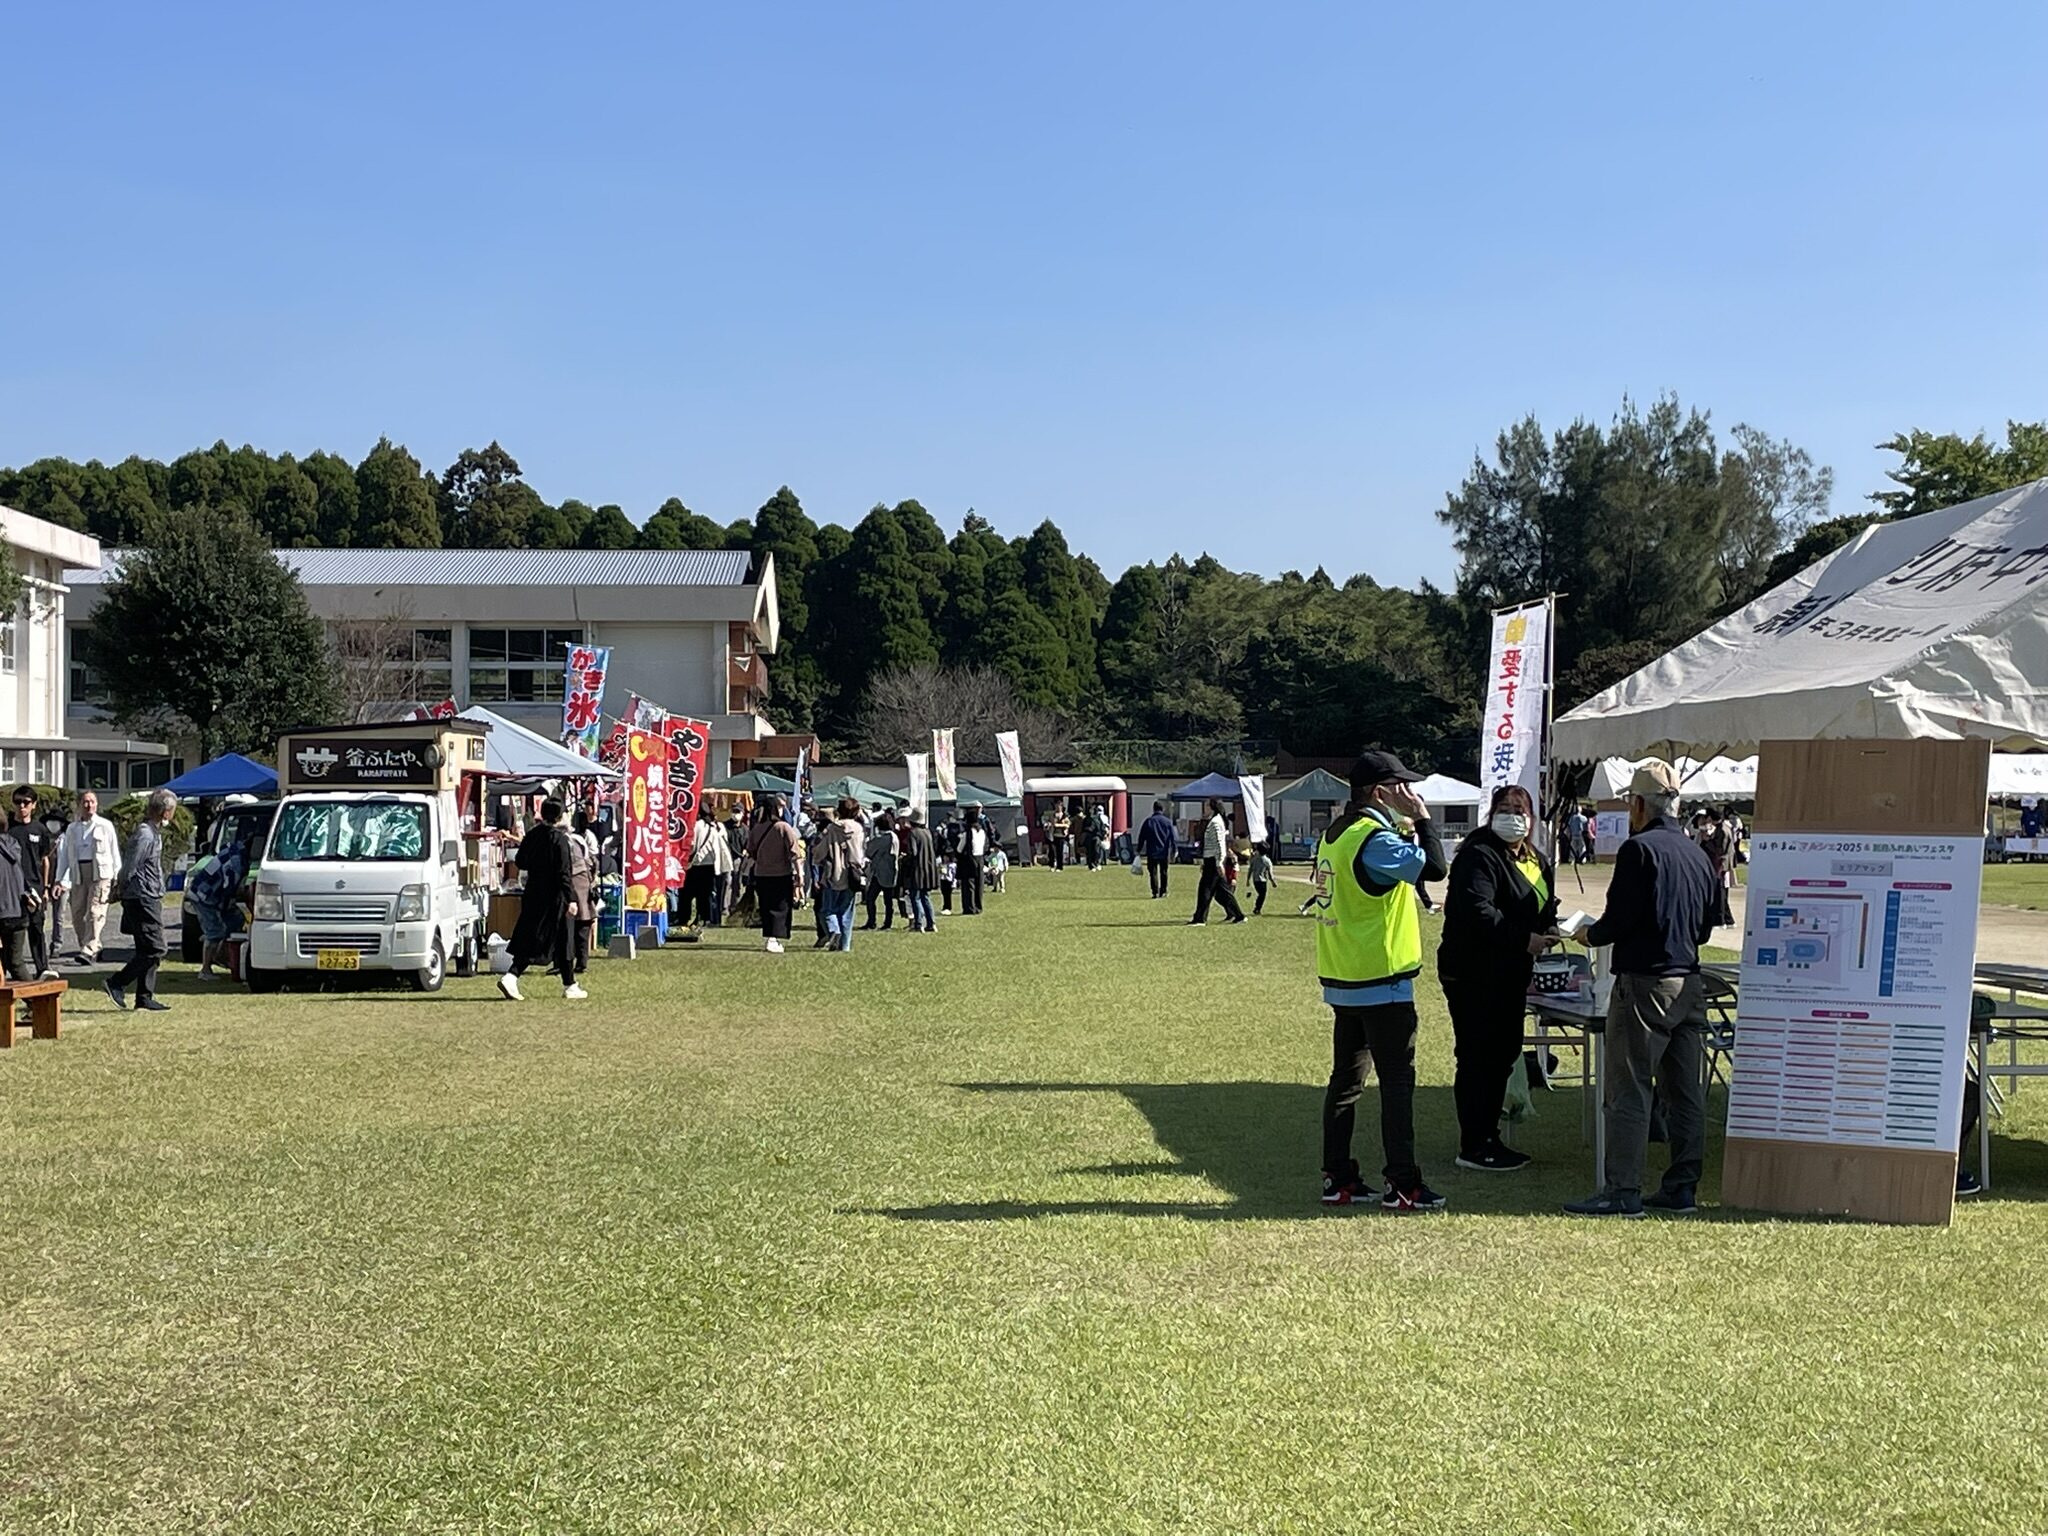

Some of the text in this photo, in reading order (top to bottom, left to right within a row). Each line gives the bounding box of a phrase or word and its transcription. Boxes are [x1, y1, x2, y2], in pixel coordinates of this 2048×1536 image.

[566, 648, 604, 730] かき氷
[647, 763, 665, 854] 焼きたて
[668, 728, 704, 841] やきいも
